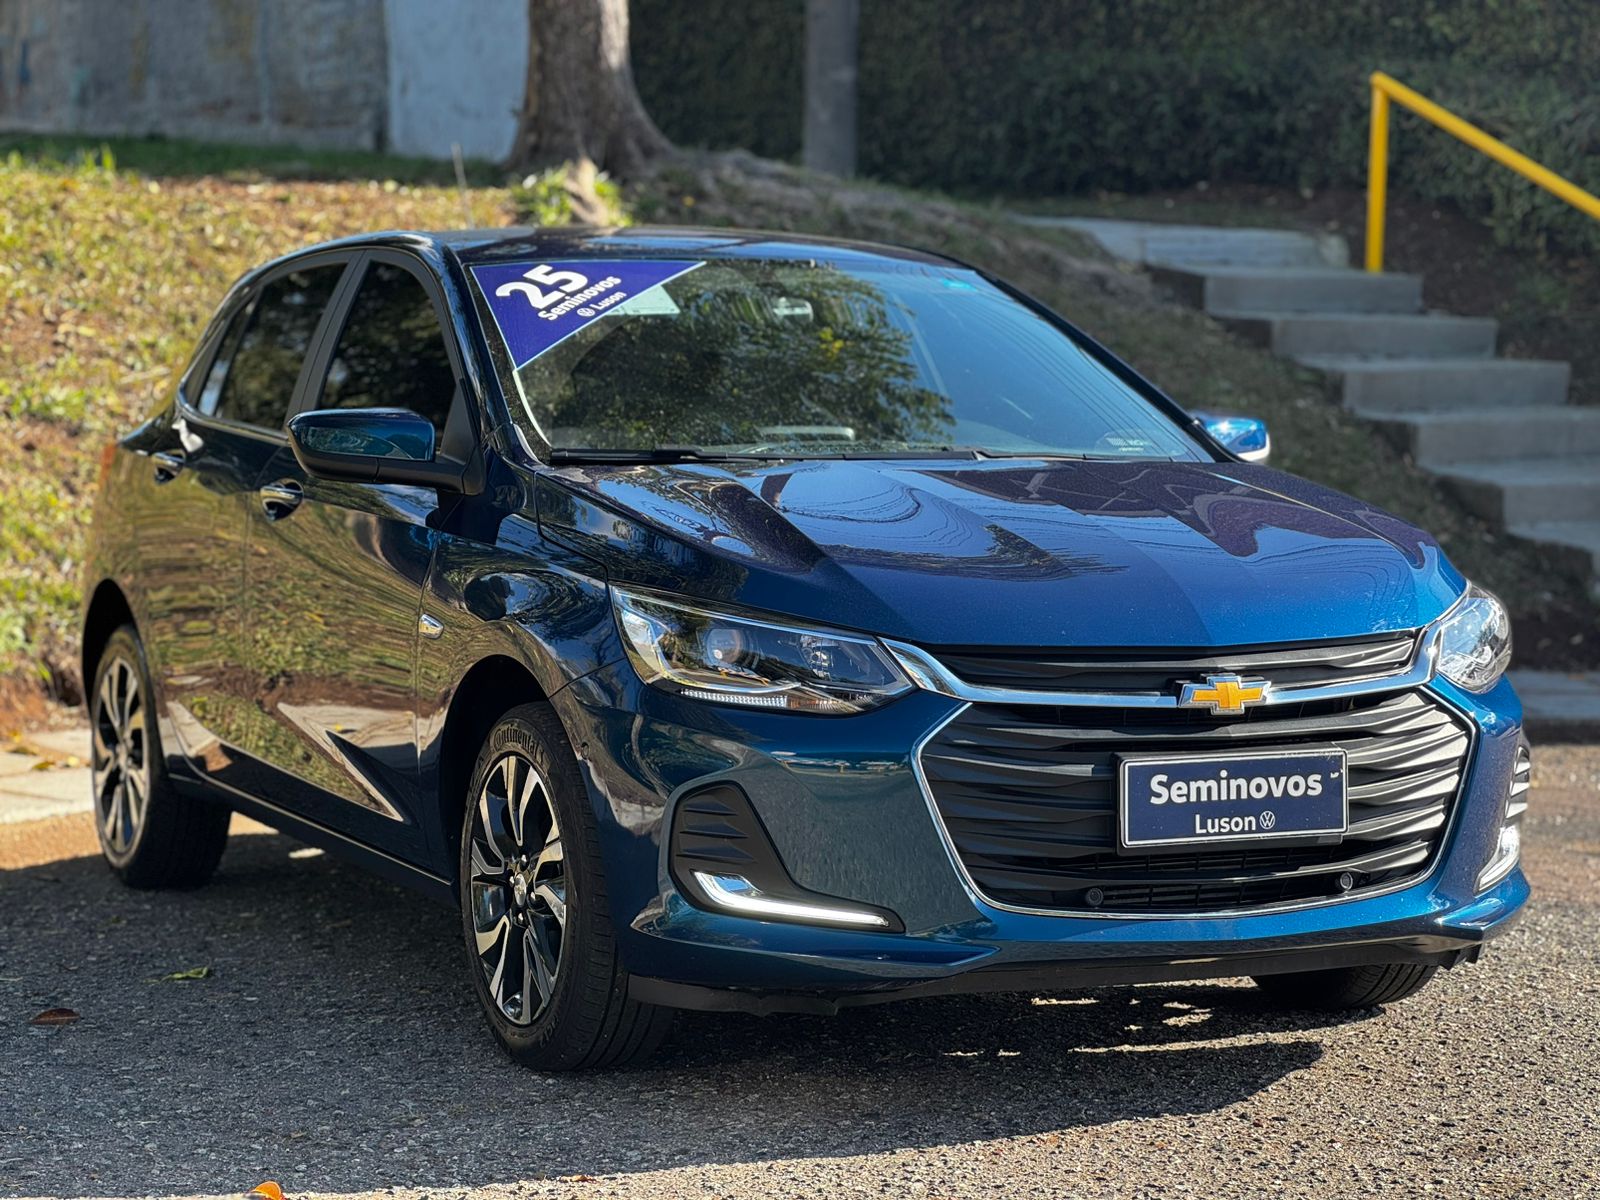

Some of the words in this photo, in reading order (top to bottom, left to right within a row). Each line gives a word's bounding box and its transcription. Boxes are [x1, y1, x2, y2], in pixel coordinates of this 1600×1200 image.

[495, 264, 589, 310] 25
[538, 275, 622, 321] Seminovos
[592, 291, 627, 311] Luson
[494, 724, 539, 760] Continental
[1149, 769, 1323, 804] Seminovos
[1195, 813, 1256, 834] Luson
